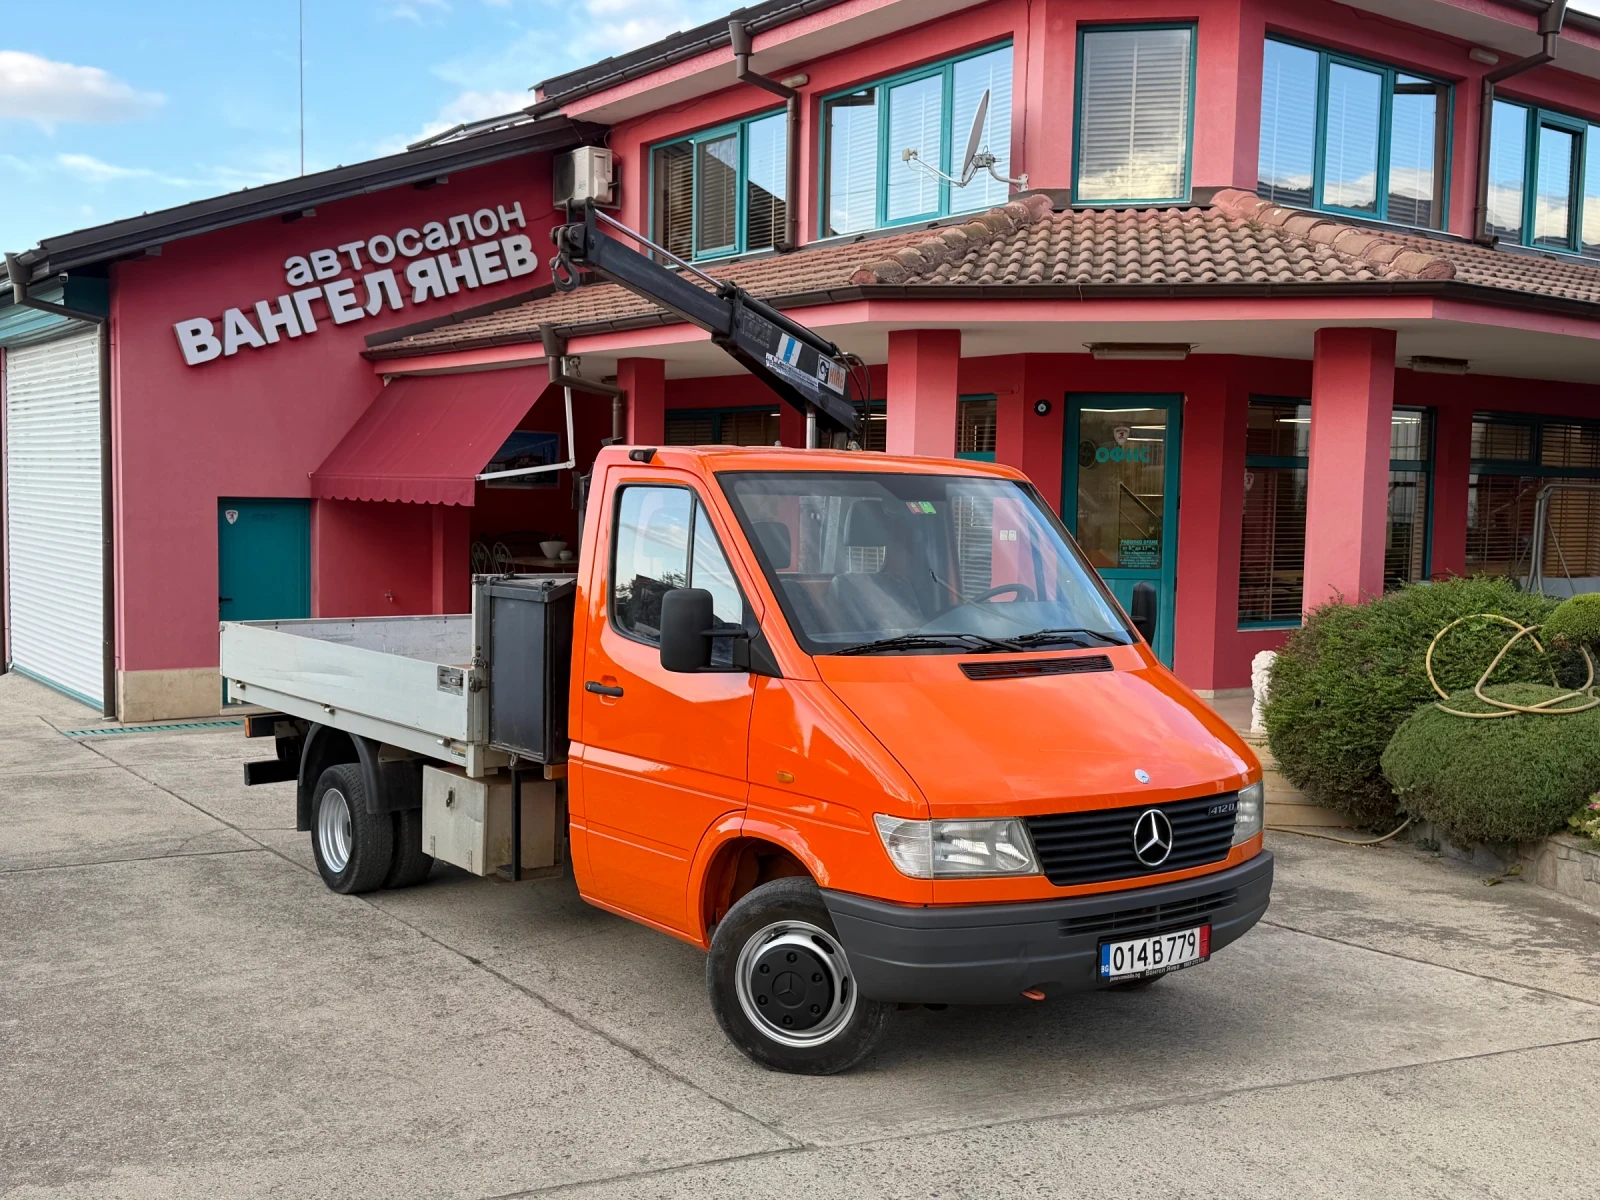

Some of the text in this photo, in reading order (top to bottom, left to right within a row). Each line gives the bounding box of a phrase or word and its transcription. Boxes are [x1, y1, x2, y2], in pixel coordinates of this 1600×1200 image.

[284, 201, 526, 287] автосалон
[173, 234, 539, 366] ВАНГЕЛ ЯНЕВ
[1096, 446, 1150, 463] ОФИС
